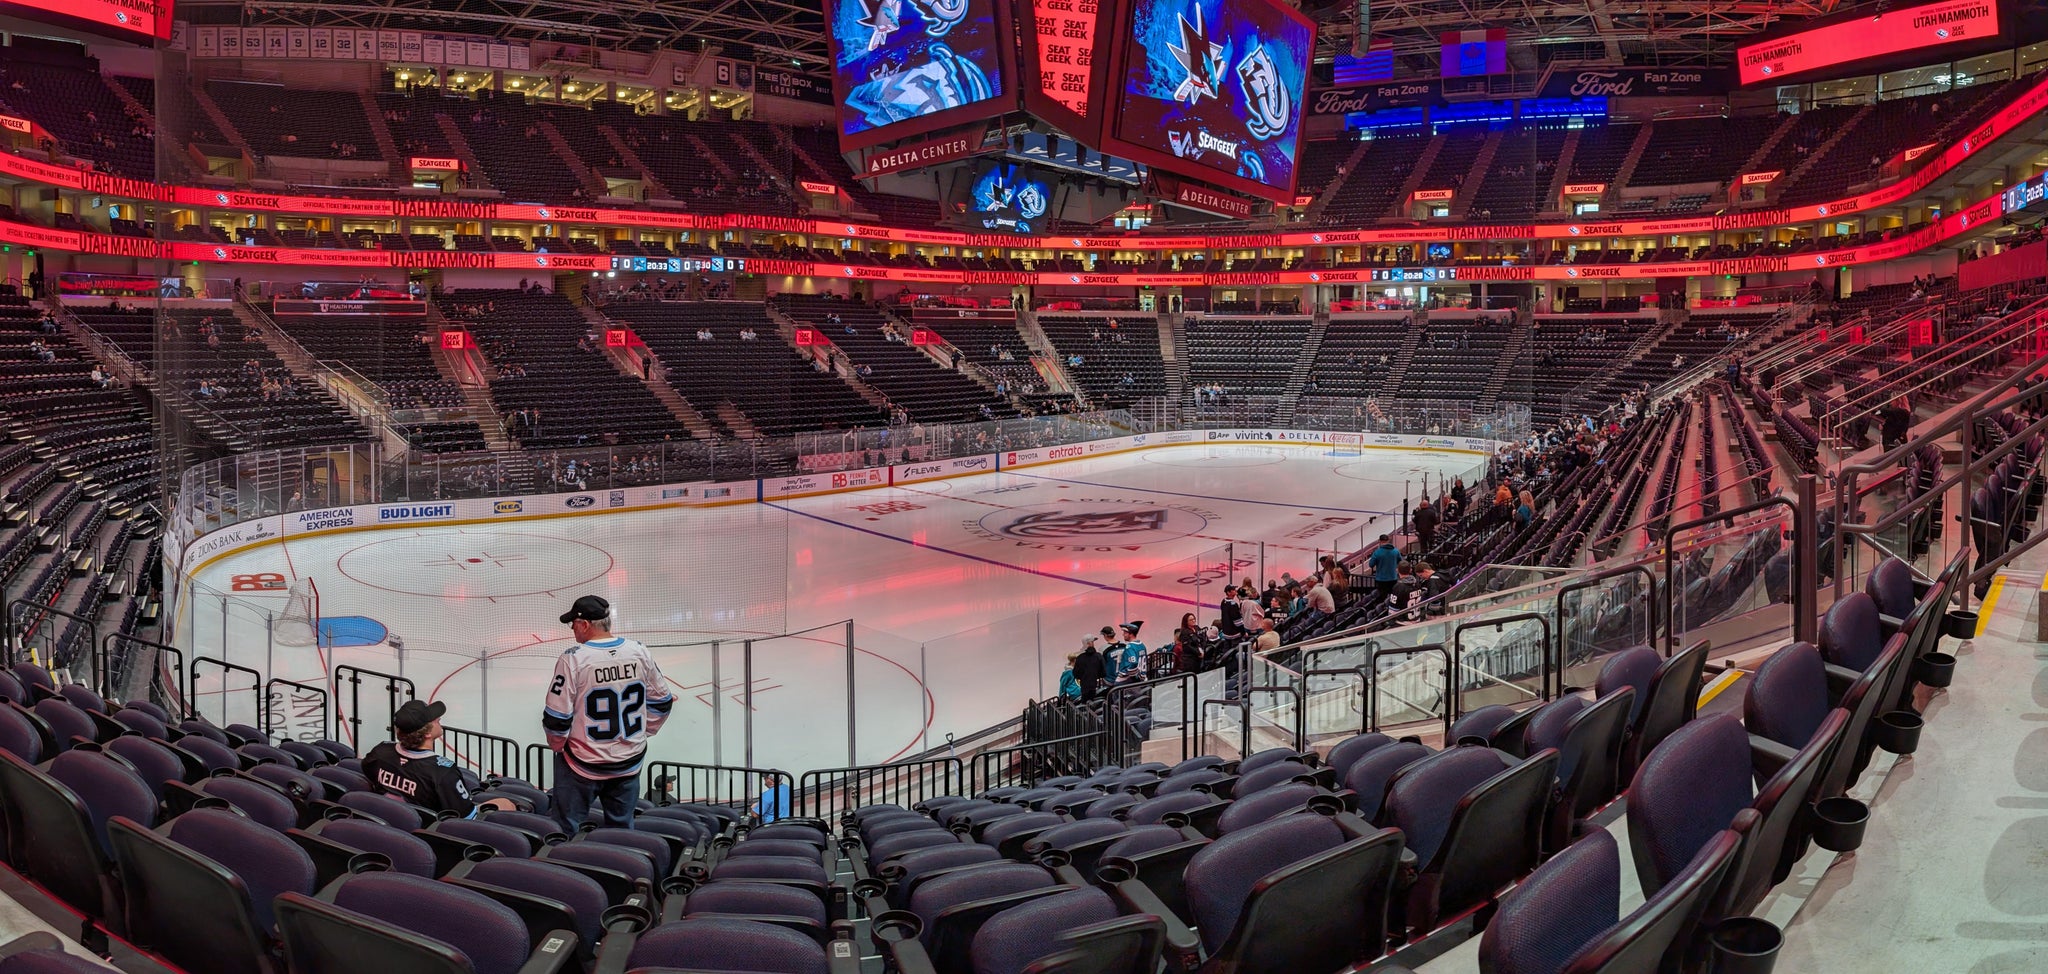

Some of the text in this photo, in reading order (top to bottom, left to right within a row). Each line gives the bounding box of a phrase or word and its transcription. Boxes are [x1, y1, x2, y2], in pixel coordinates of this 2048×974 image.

[1048, 1, 1072, 12] GEEK
[1913, 6, 1989, 28] UTAH MAMMOTH
[1064, 19, 1087, 30] SEAT
[1062, 29, 1087, 40] GEEK
[203, 38, 209, 46] 1
[223, 38, 238, 47] 35
[246, 38, 260, 47] 53
[270, 39, 283, 47] 14
[295, 39, 302, 47] 9
[315, 40, 327, 48] 12
[337, 40, 350, 49] 32
[363, 41, 370, 49] 4
[1048, 44, 1071, 55] SEAT
[1744, 53, 1762, 67] UTAH
[1763, 43, 1802, 62] MAMMOTH
[1046, 54, 1071, 65] GEEK
[674, 67, 684, 82] 6
[718, 65, 729, 81] 6
[758, 71, 812, 88] TEE BOX
[1063, 72, 1085, 84] SEAT
[1645, 73, 1701, 82] Fan Zone
[1061, 82, 1085, 93] GEEK
[1378, 84, 1429, 97] Fan Zone
[1570, 72, 1633, 96] Ford
[770, 85, 801, 97] LOUNGE
[1315, 90, 1369, 114] Ford
[1198, 131, 1237, 160] SEATGEEK
[882, 139, 967, 169] DELTA CENTER
[419, 160, 451, 168] SEATGEEK
[1748, 174, 1774, 182] SEATGEEK
[81, 170, 110, 194] UTAH
[112, 177, 175, 202] MAMMOTH
[807, 184, 830, 192] SEATGEEK
[1420, 191, 1446, 199] SEATGEEK
[2009, 191, 2015, 208] 0
[2026, 183, 2044, 202] 20:26
[233, 195, 280, 209] SEATGEEK
[1191, 191, 1249, 215] DELTA CENTER
[1829, 199, 1859, 214] SEATGEEK
[392, 200, 426, 216] UTAH
[429, 202, 498, 219] MAMMOTH
[554, 209, 598, 221] SEATGEEK
[692, 215, 719, 229] UTAH
[735, 213, 817, 233] UTAH MAMMOTH
[1712, 214, 1738, 230] UTAH
[1739, 210, 1790, 228] MAMMOTH
[859, 227, 890, 238] SEATGEEK
[1447, 227, 1475, 240] UTAH
[1477, 226, 1534, 239] MAMMOTH
[1584, 225, 1623, 235] SEATGEEK
[965, 234, 989, 246] UTAH
[991, 234, 1041, 248] MAMMOTH
[1086, 239, 1121, 247] SEATGEEK
[1205, 236, 1229, 248] UTAH
[1232, 235, 1282, 248] MAMMOTH
[1325, 233, 1360, 242] SEATGEEK
[80, 232, 109, 254] UTAH
[111, 236, 174, 259] MAMMOTH
[231, 248, 278, 262] SEATGEEK
[391, 252, 426, 267] UTAH
[428, 252, 495, 268] MAMMOTH
[1828, 250, 1856, 264] SEATGEEK
[552, 257, 595, 268] SEATGEEK
[624, 258, 734, 271] 0 20:33 0 0
[763, 261, 815, 276] MAMMOTH
[1710, 261, 1736, 275] UTAH
[1738, 257, 1788, 273] MAMMOTH
[857, 268, 888, 278] SEATGEEK
[963, 271, 986, 284] UTAH
[989, 272, 1039, 285] MAMMOTH
[1203, 273, 1227, 285] UTAH
[1230, 273, 1280, 285] MAMMOTH
[1323, 272, 1358, 281] SEATGEEK
[1382, 270, 1446, 280] 0 20:28 0
[1475, 267, 1530, 280] MAMMOTH
[1582, 268, 1620, 277] SEATGEEK
[1084, 276, 1119, 284] SEATGEEK
[1235, 431, 1264, 441] vivint
[1049, 445, 1083, 459] entrata
[567, 471, 576, 480] 77
[911, 466, 941, 475] FILEVINE
[832, 473, 847, 488] PB
[571, 497, 590, 507] Ford
[299, 509, 353, 522] AMERICAN
[381, 505, 452, 520] BUD LIGHT
[306, 518, 354, 531] EXPRESS
[198, 531, 242, 558] ZIONS BANK
[595, 663, 638, 684] COOLEY
[551, 674, 566, 696] 2
[585, 680, 647, 741] 92
[291, 692, 326, 743] BANK
[378, 768, 417, 797] KELLER
[456, 779, 469, 800] 9
